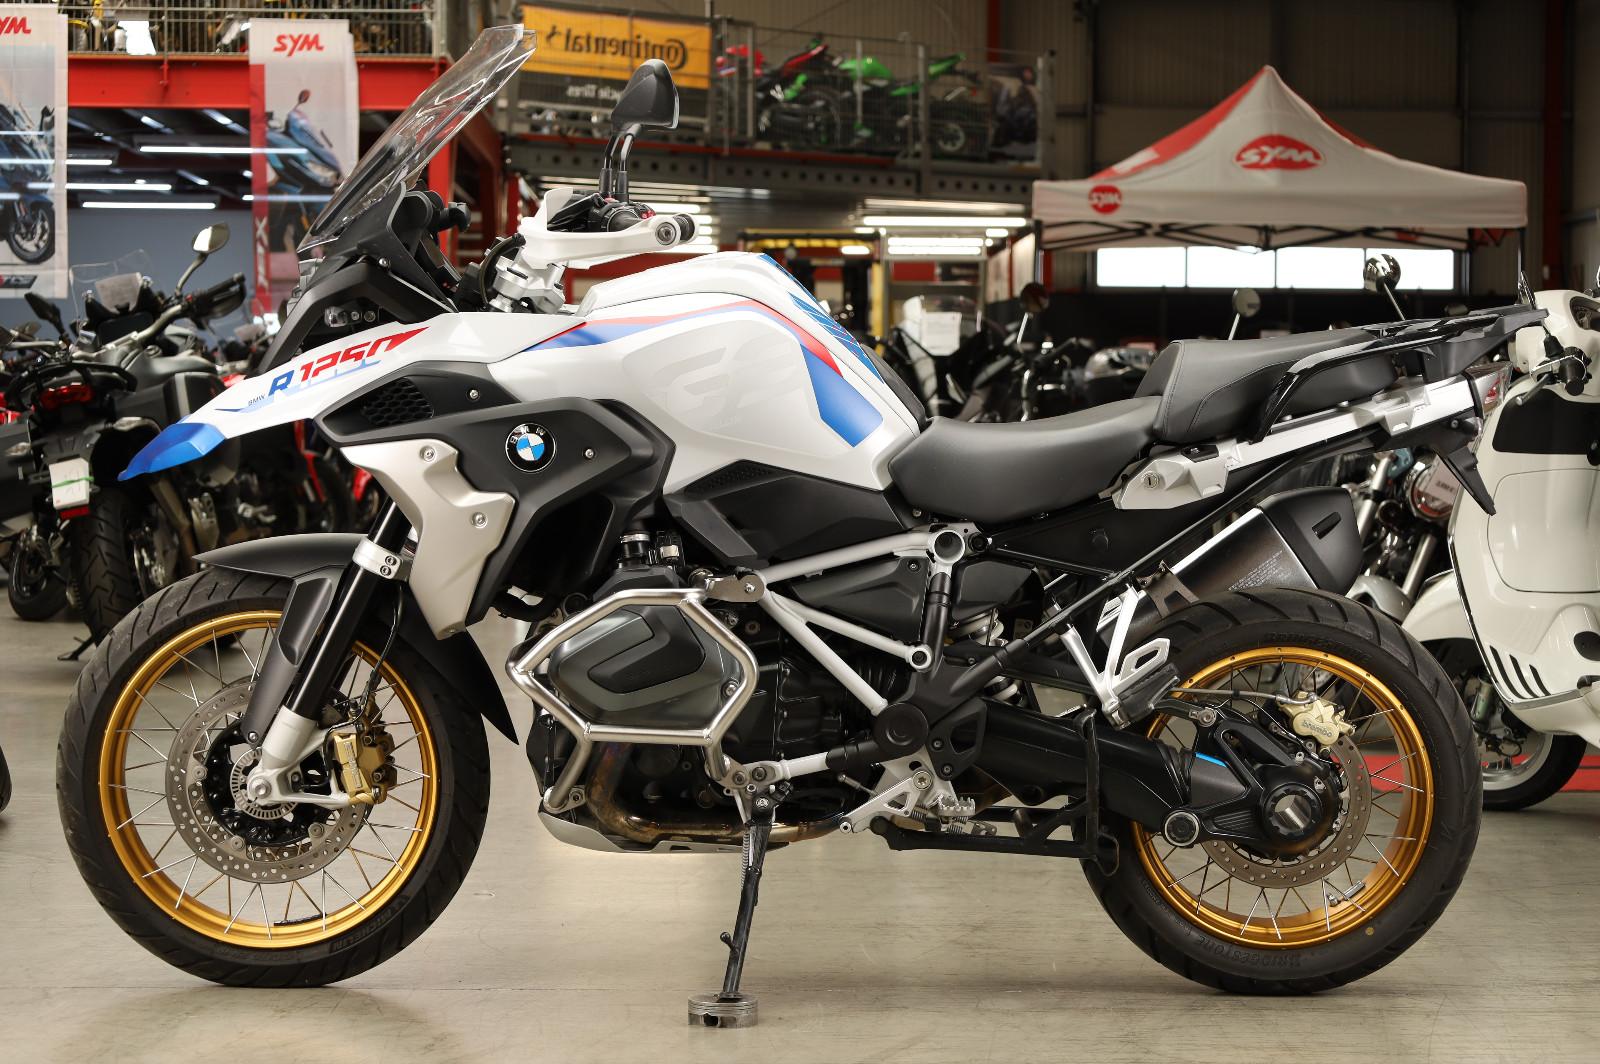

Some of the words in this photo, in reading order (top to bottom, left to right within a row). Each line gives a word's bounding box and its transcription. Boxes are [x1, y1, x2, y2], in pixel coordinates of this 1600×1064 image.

[0, 16, 32, 36] YM
[273, 33, 324, 57] SYM
[1236, 145, 1325, 165] SYM
[268, 369, 294, 396] R
[510, 425, 546, 444] BMW
